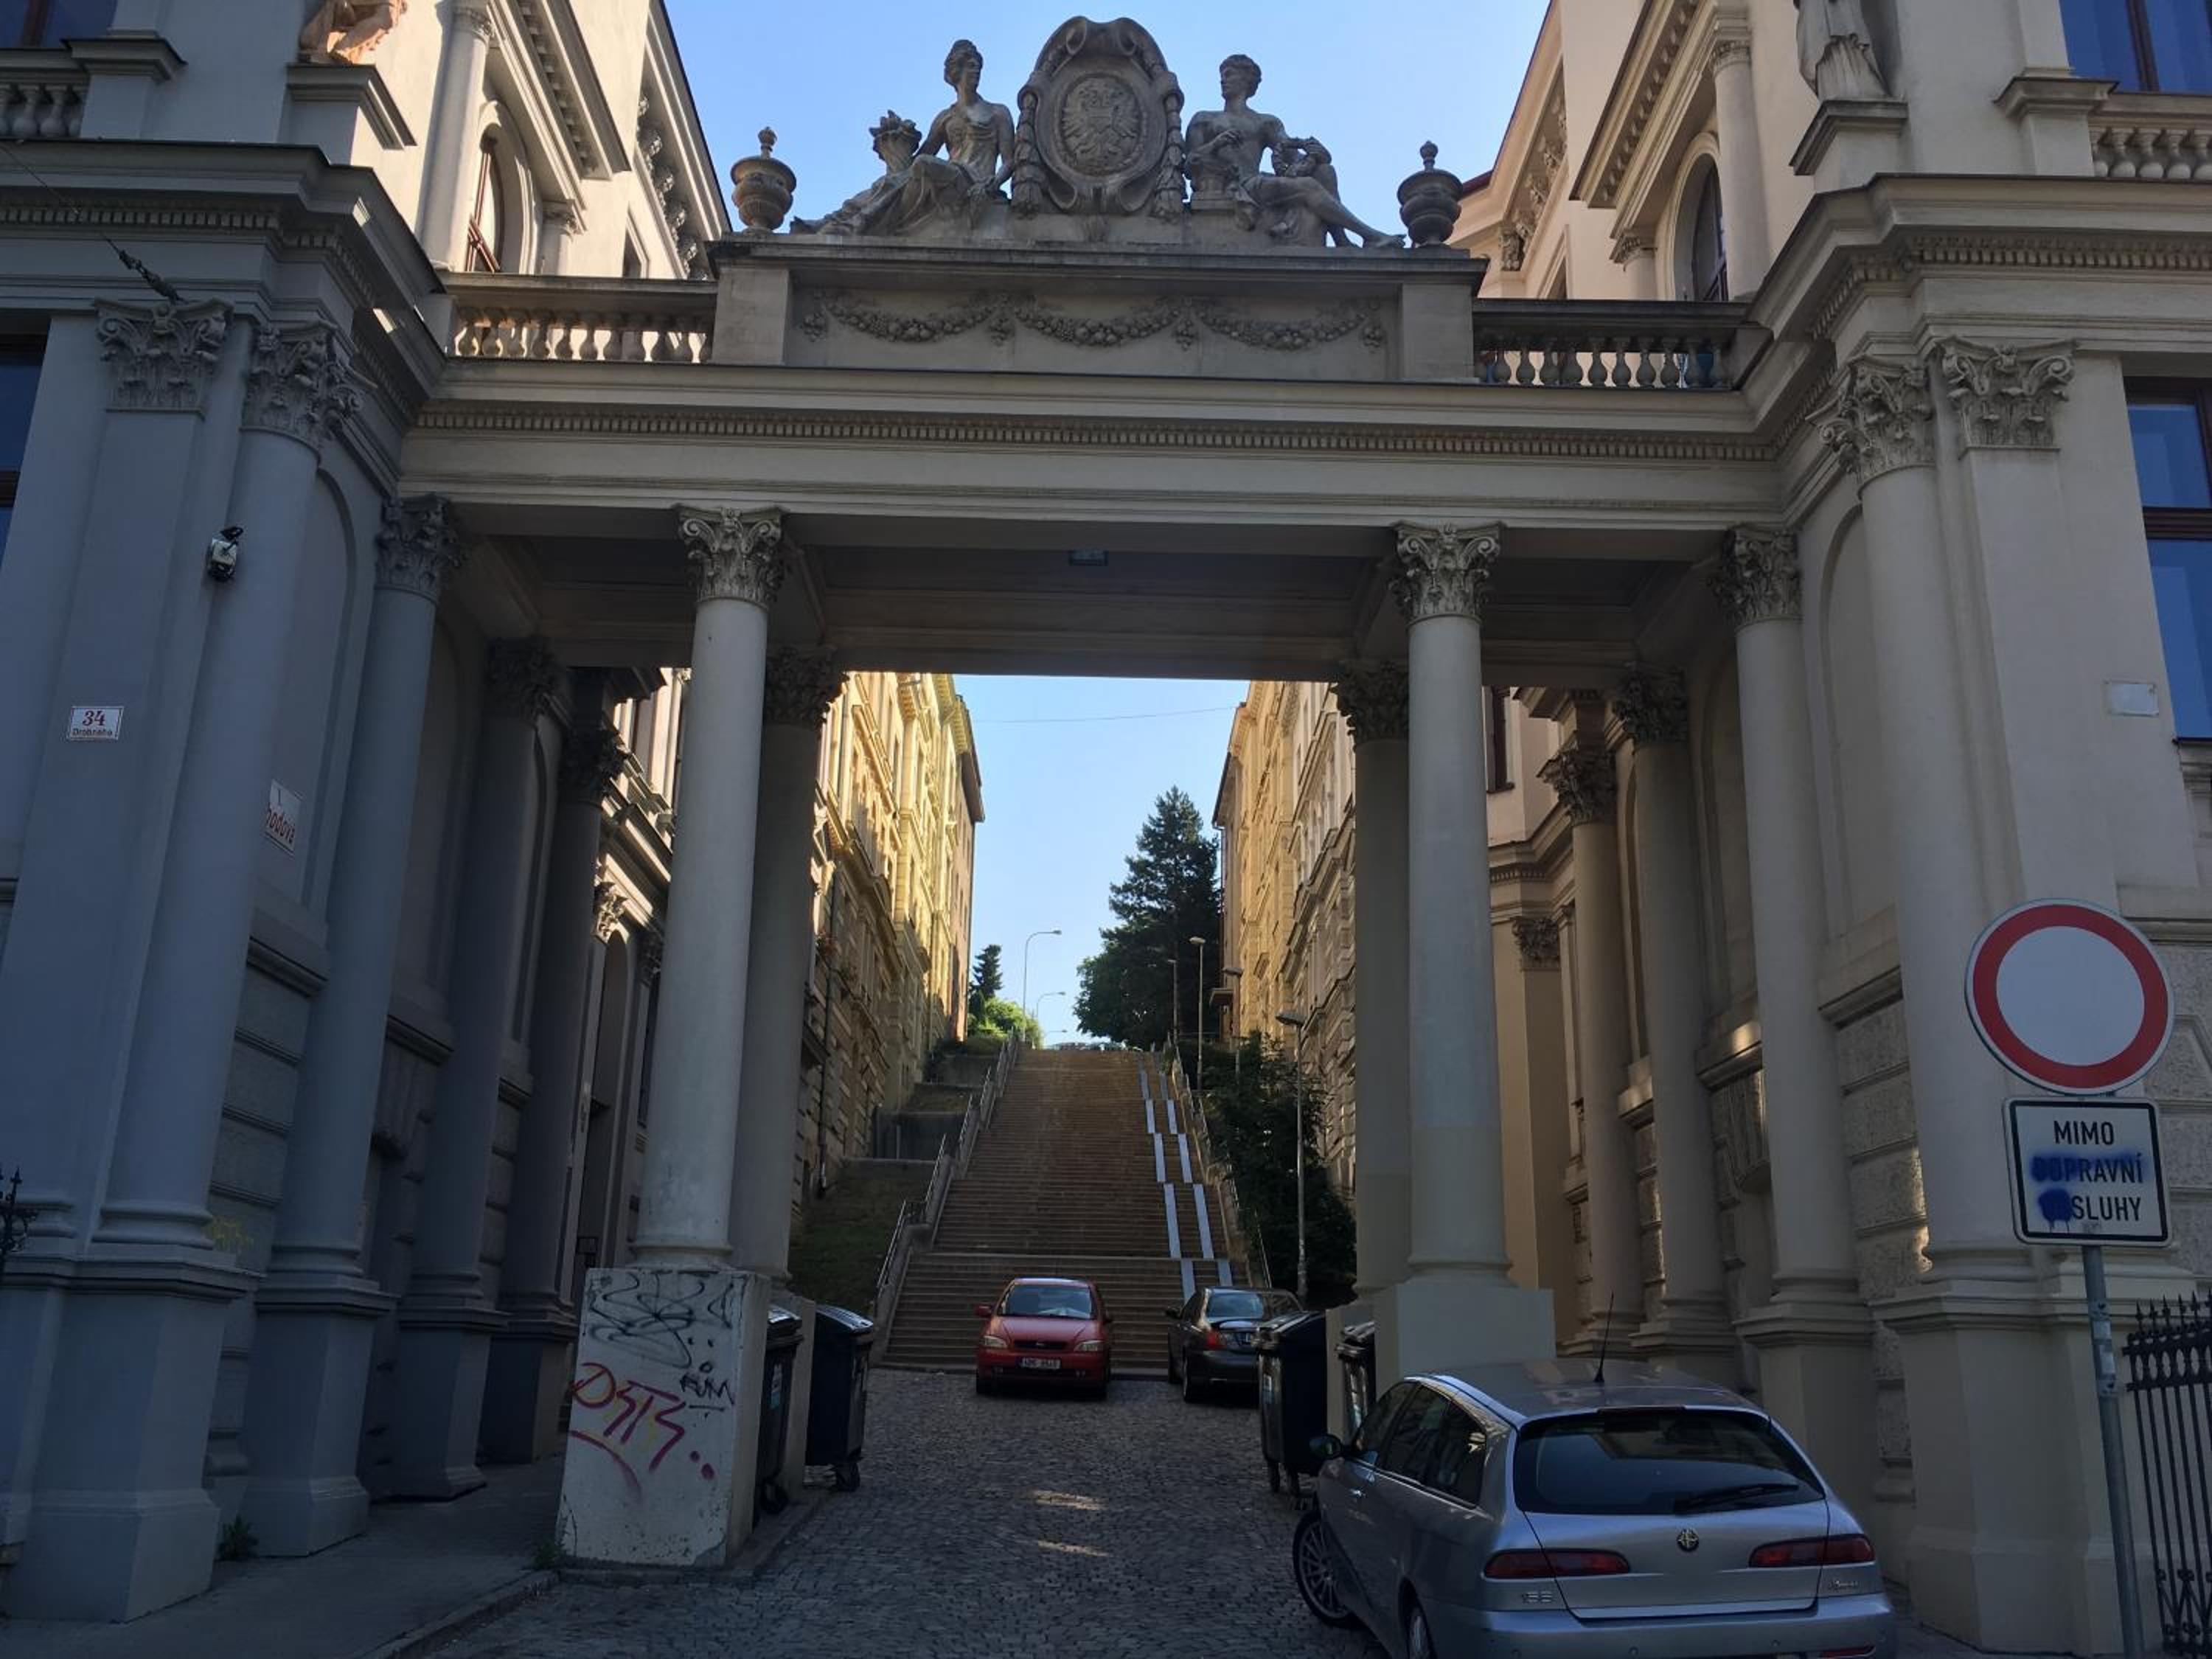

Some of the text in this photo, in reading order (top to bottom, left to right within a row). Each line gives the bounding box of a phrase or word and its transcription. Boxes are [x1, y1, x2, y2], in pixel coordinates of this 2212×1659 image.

[82, 710, 105, 726] 34
[2053, 1120, 2115, 1145] MIMO
[2050, 1194, 2142, 1222] SLUHY
